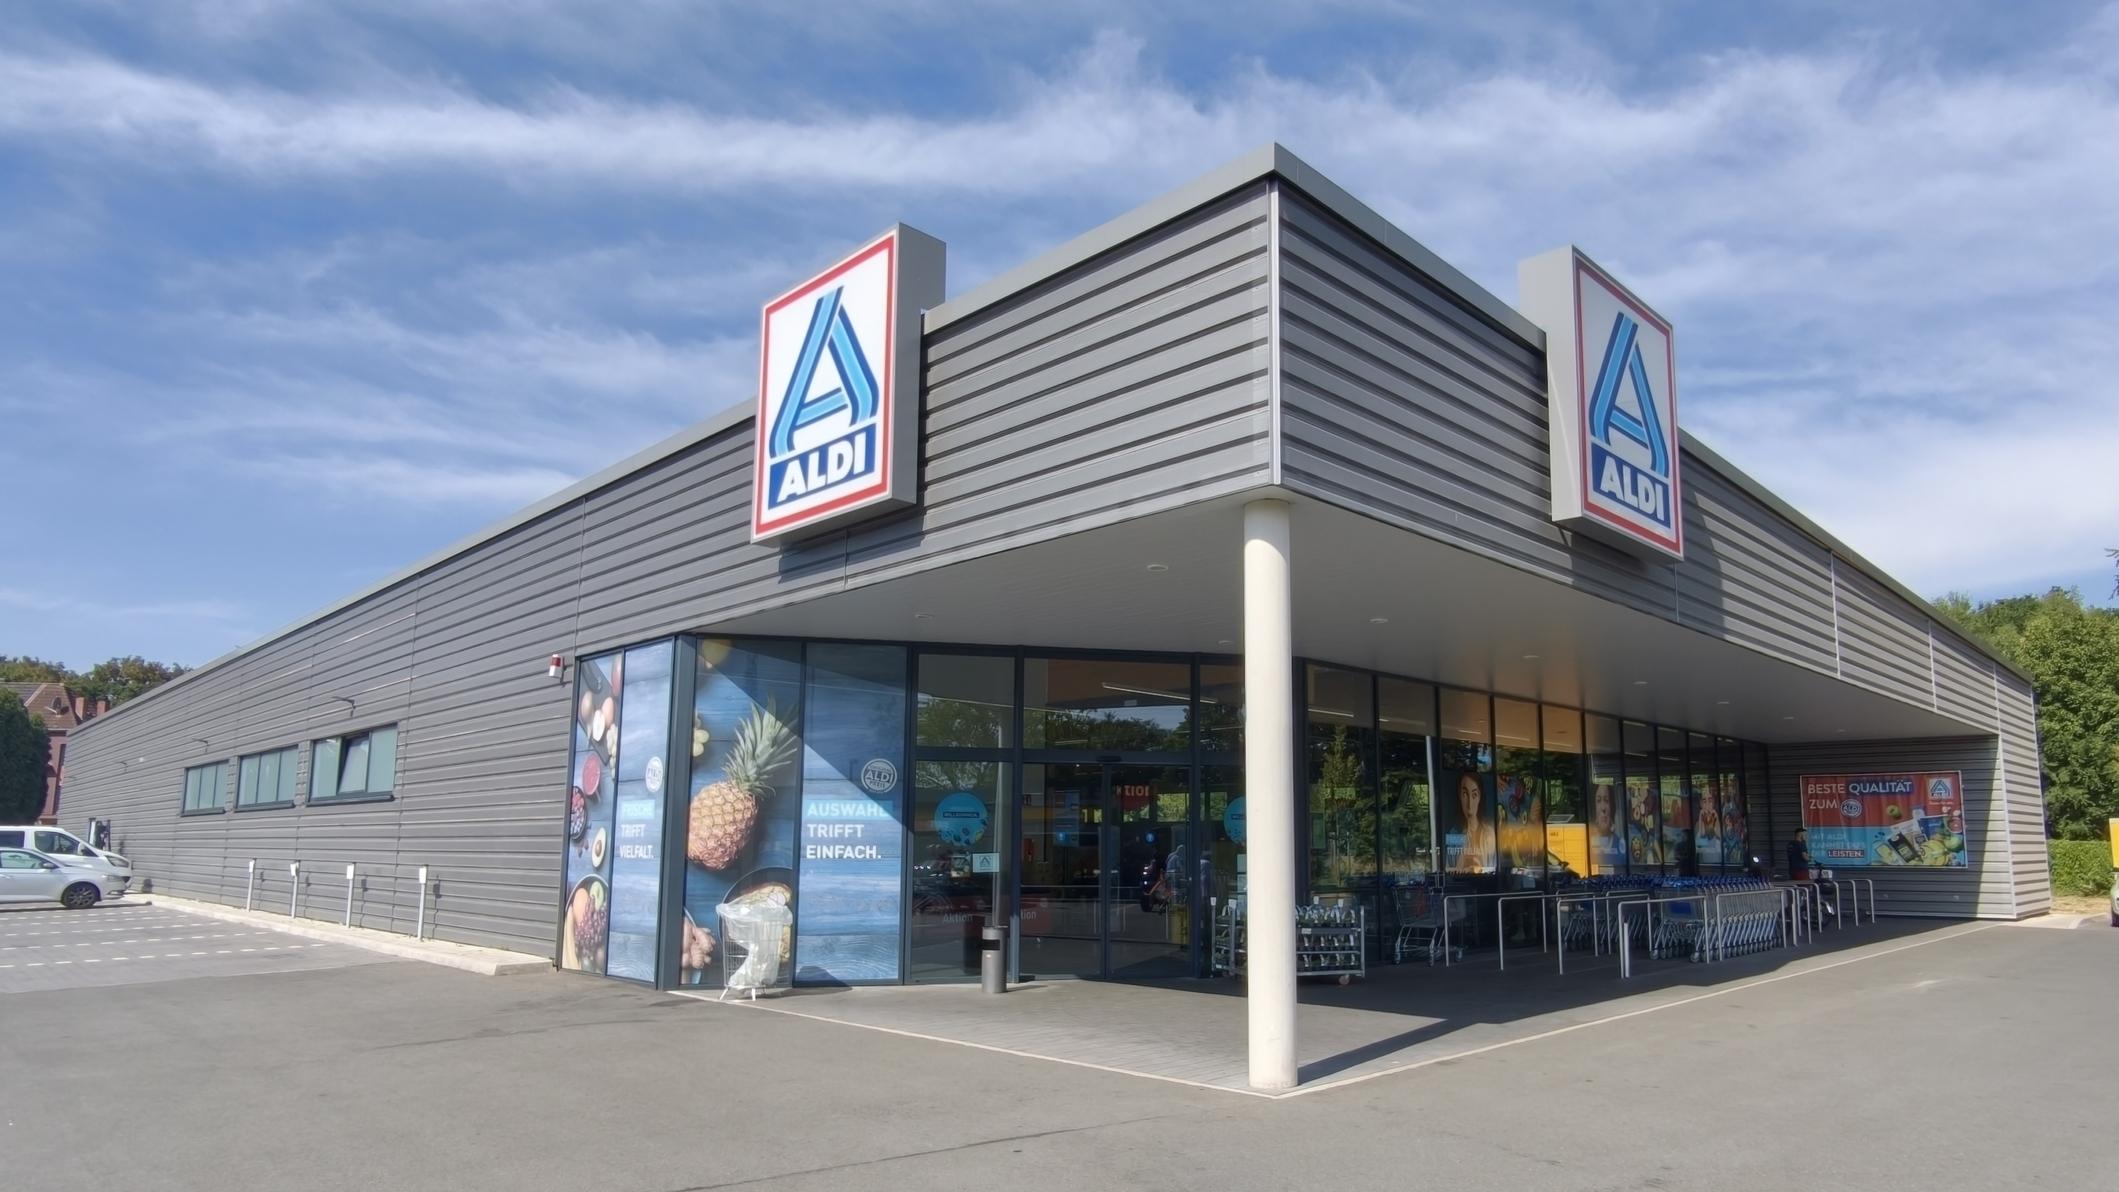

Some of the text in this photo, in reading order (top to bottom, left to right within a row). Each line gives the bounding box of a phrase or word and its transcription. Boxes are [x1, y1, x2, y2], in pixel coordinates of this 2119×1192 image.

[777, 431, 867, 503] ALDI
[1600, 456, 1665, 521] ALDI
[865, 770, 894, 784] ALDI
[1808, 780, 1912, 795] BESTE QUALITÄT
[807, 802, 892, 818] AUSWAHL
[1809, 799, 1838, 809] ZUM
[621, 824, 646, 837] TRIFFT
[807, 824, 865, 837] TRIFFT
[620, 845, 655, 859] VIELFALT.
[806, 844, 882, 859] EINFACH.
[1828, 850, 1864, 858] LEISTEN.
